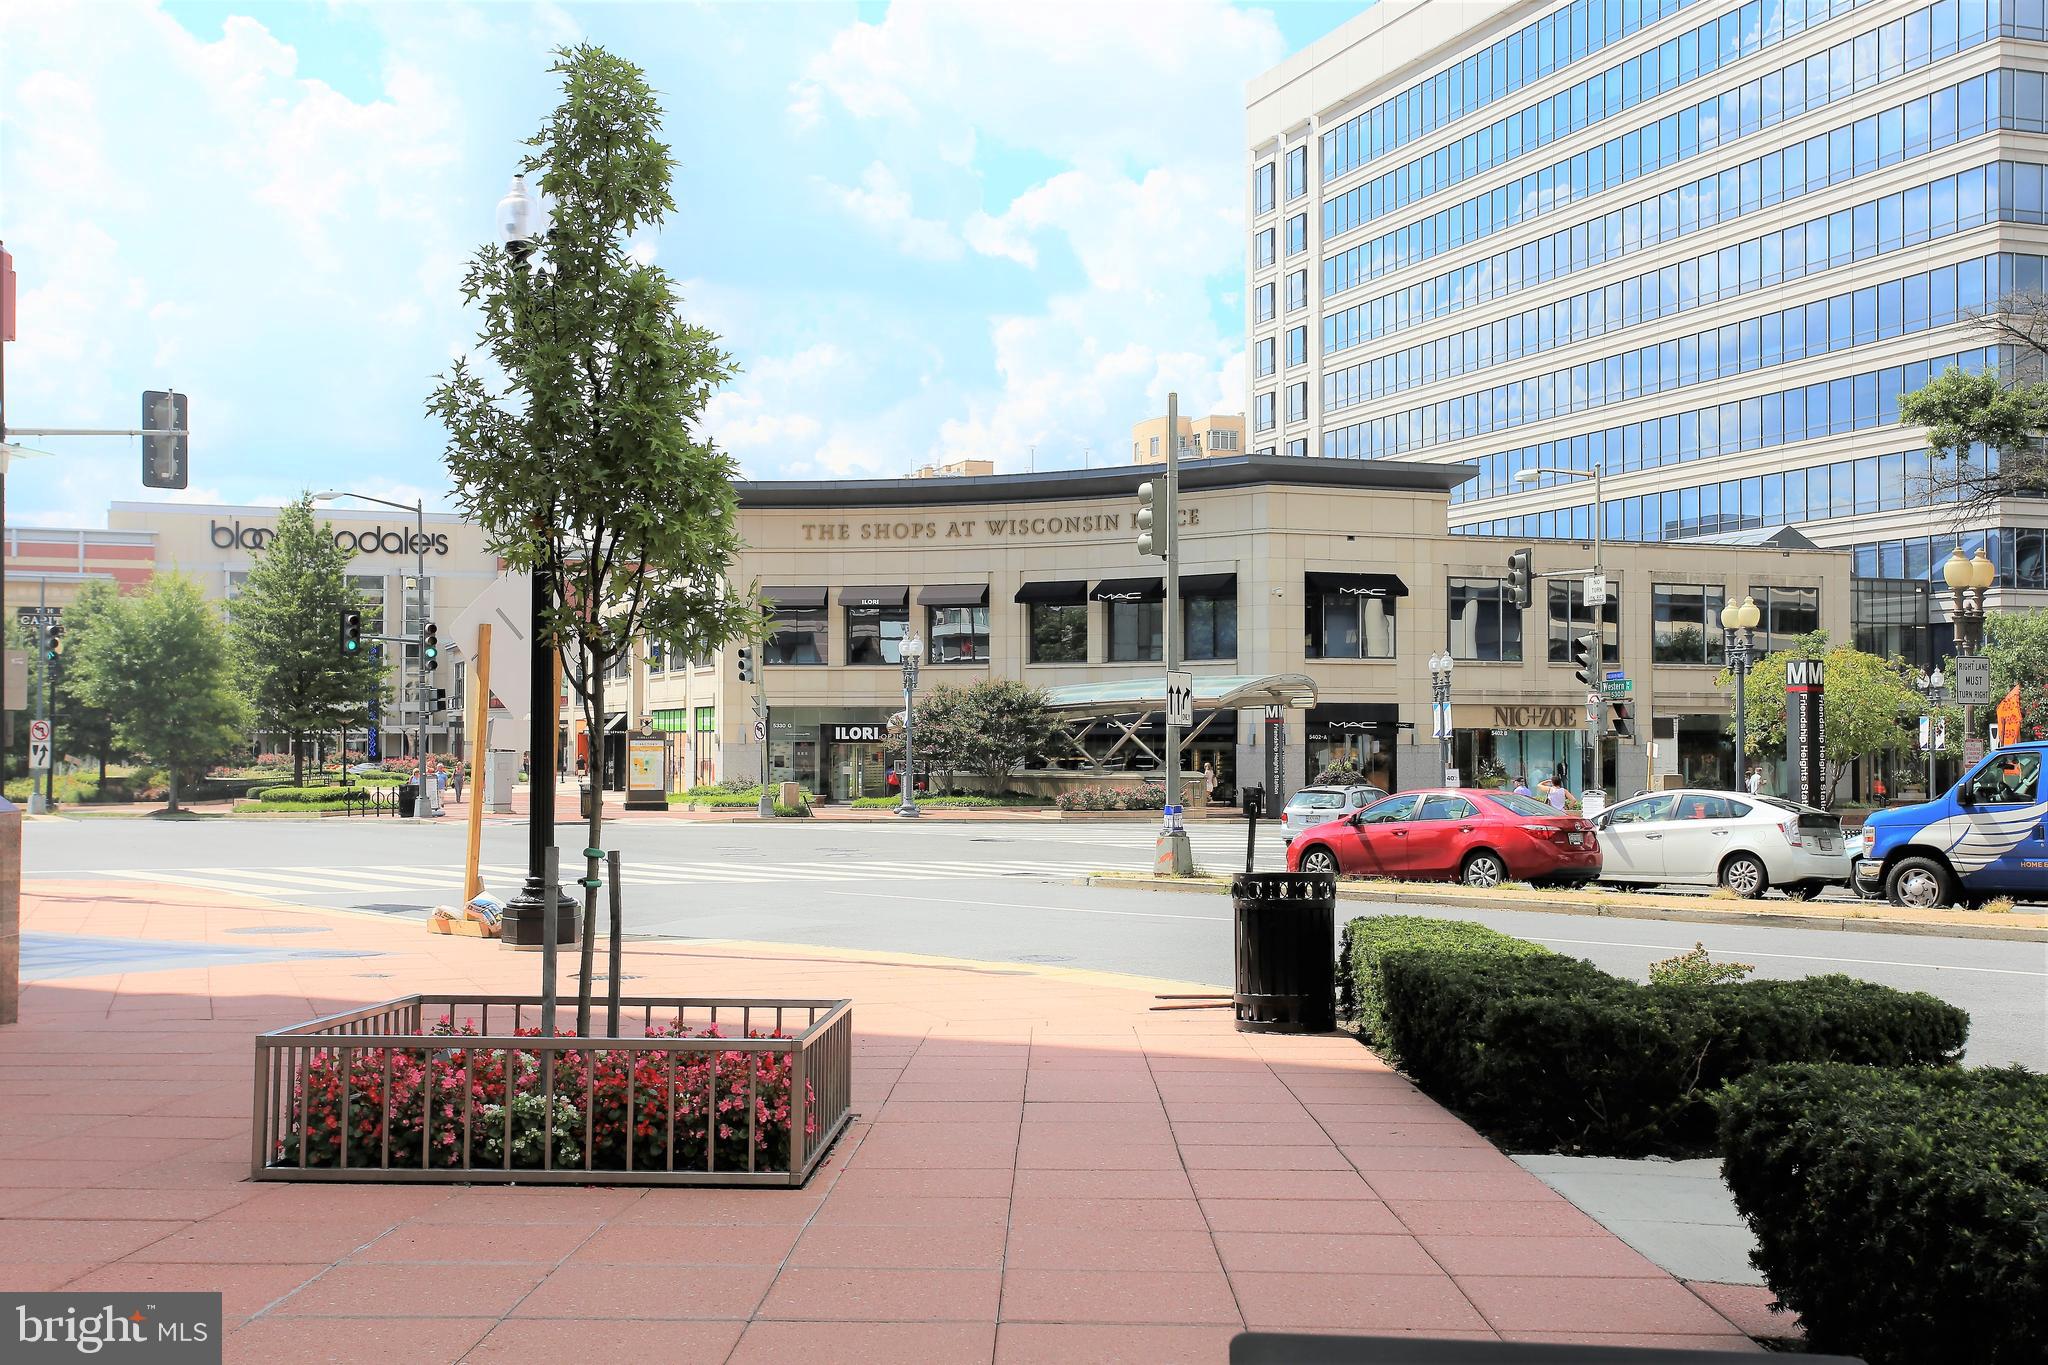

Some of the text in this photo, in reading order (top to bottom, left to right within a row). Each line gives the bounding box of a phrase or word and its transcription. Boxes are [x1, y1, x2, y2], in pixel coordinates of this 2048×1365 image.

[802, 523, 850, 540] THE
[861, 522, 936, 540] SHOPS
[946, 521, 976, 537] AT
[985, 513, 1120, 536] WISCONSIN
[1097, 592, 1142, 600] MAC
[1340, 587, 1386, 596] MAC
[1787, 662, 1807, 684] M
[1808, 662, 1823, 684] M
[1959, 663, 1988, 671] RIGHT LANE
[1602, 681, 1625, 692] Western
[1965, 676, 1982, 686] MUST
[1959, 691, 1988, 699] TURN RIGHT
[1265, 705, 1278, 719] M
[1494, 706, 1577, 727] NIC+ZOE
[1799, 693, 1808, 743] Friendship
[1329, 721, 1377, 729] MAC
[835, 726, 879, 740] ILORI
[1799, 745, 1808, 781] Heights
